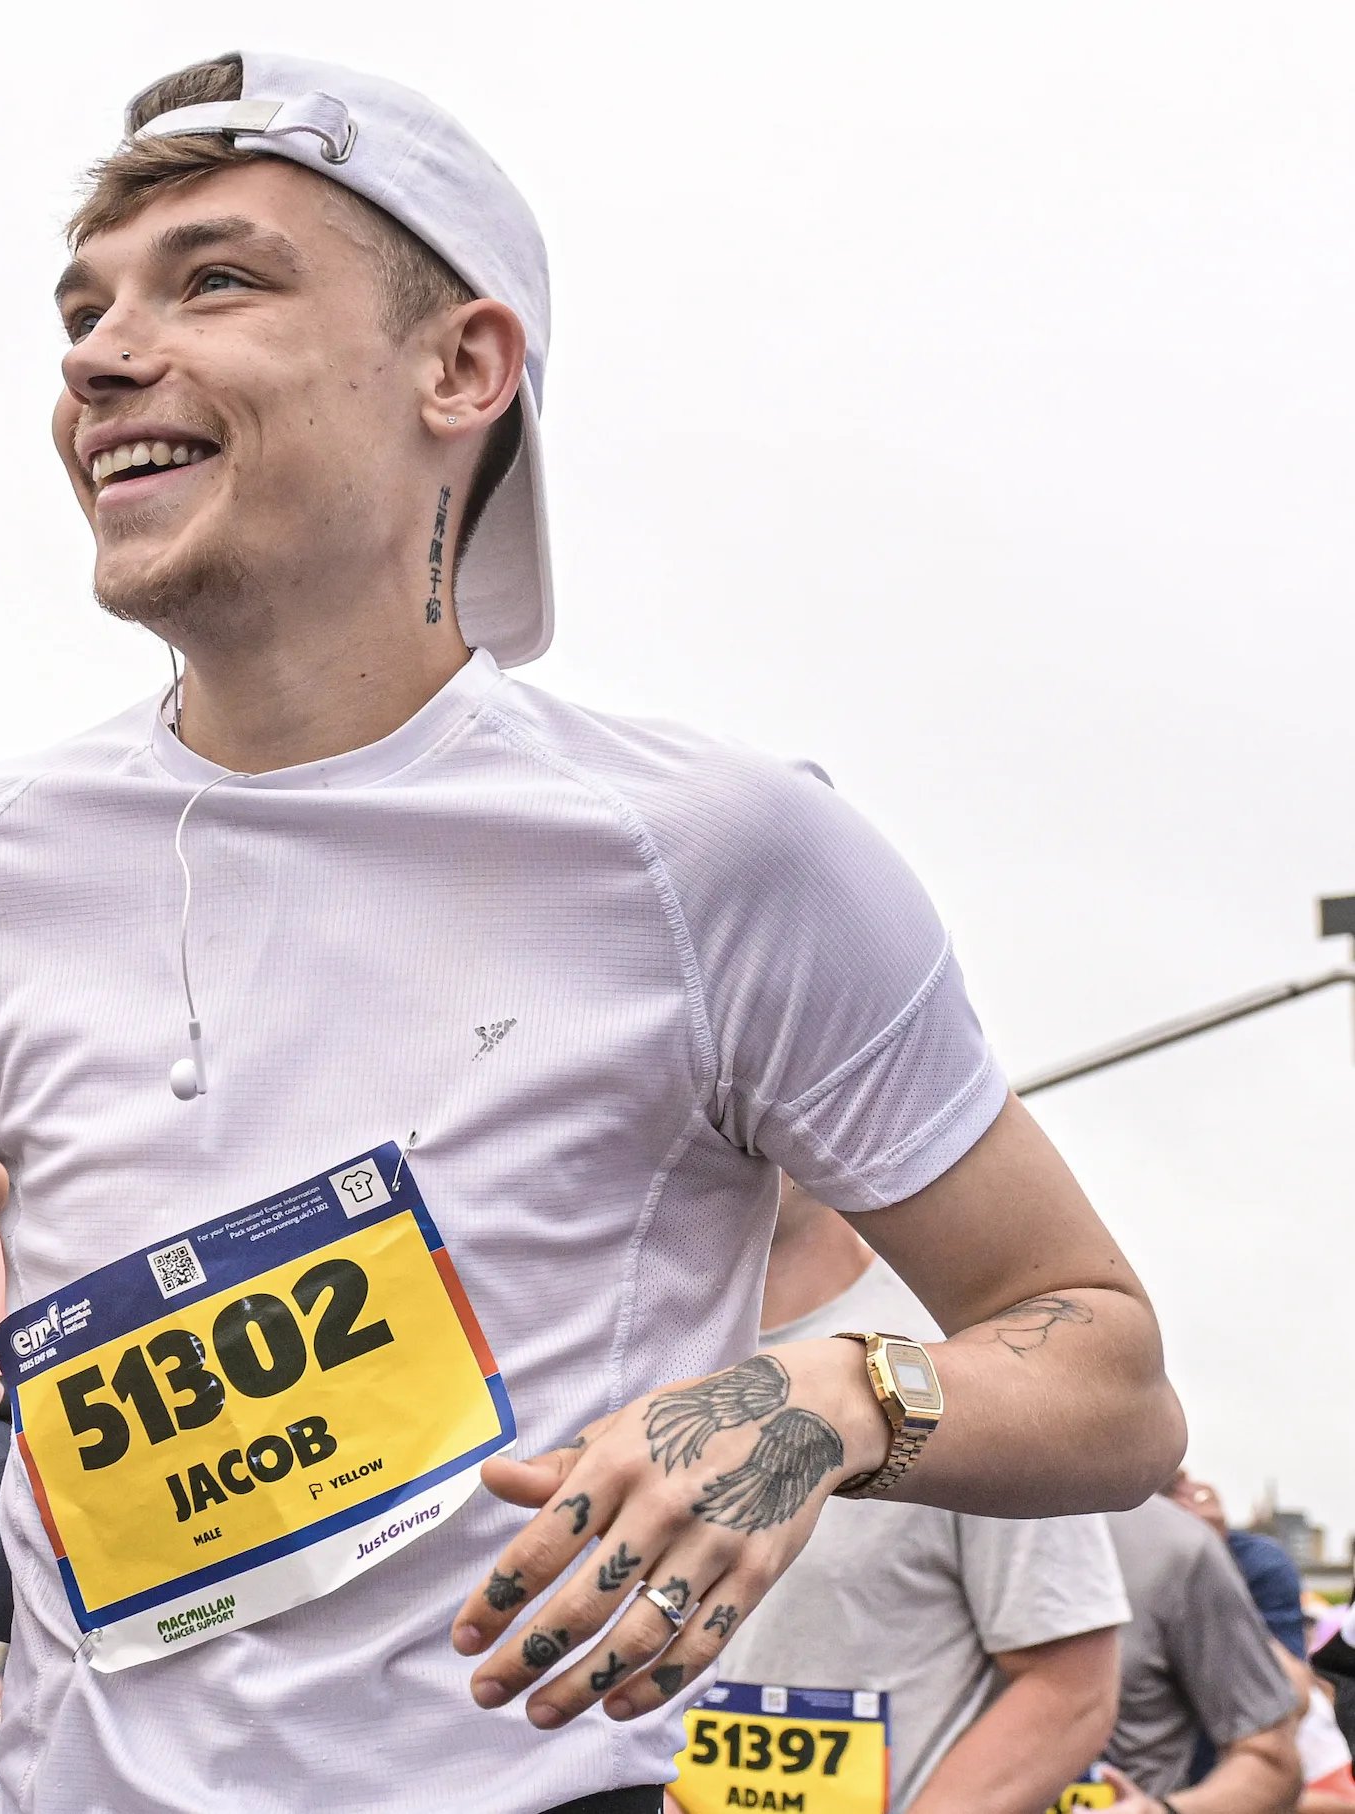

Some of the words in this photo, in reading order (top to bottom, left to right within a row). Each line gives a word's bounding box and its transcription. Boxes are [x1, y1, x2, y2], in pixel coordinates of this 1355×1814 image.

[197, 1234, 209, 1242] For
[210, 1227, 224, 1239] your
[225, 1210, 264, 1230] Personalised
[264, 1202, 283, 1214] Event
[283, 1186, 321, 1205] Information
[230, 1229, 246, 1239] Pack
[246, 1223, 261, 1232] scan
[260, 1217, 272, 1226] the
[272, 1211, 285, 1221] QR
[285, 1205, 301, 1215] code
[309, 1195, 323, 1204] visit
[250, 1202, 330, 1242] docs.myrunning.uk/51302
[11, 1302, 62, 1357] emf
[57, 1258, 395, 1471] 51302
[165, 1415, 338, 1523] JACOB
[329, 1458, 383, 1489] YELLOW
[193, 1527, 222, 1546] MALE
[356, 1503, 441, 1560] JustGiving
[157, 1594, 236, 1635] MACMILLAN
[163, 1625, 196, 1643] CANCER
[196, 1609, 235, 1631] SUPPORT
[692, 1719, 851, 1776] 51397
[726, 1785, 806, 1813] ADAM
